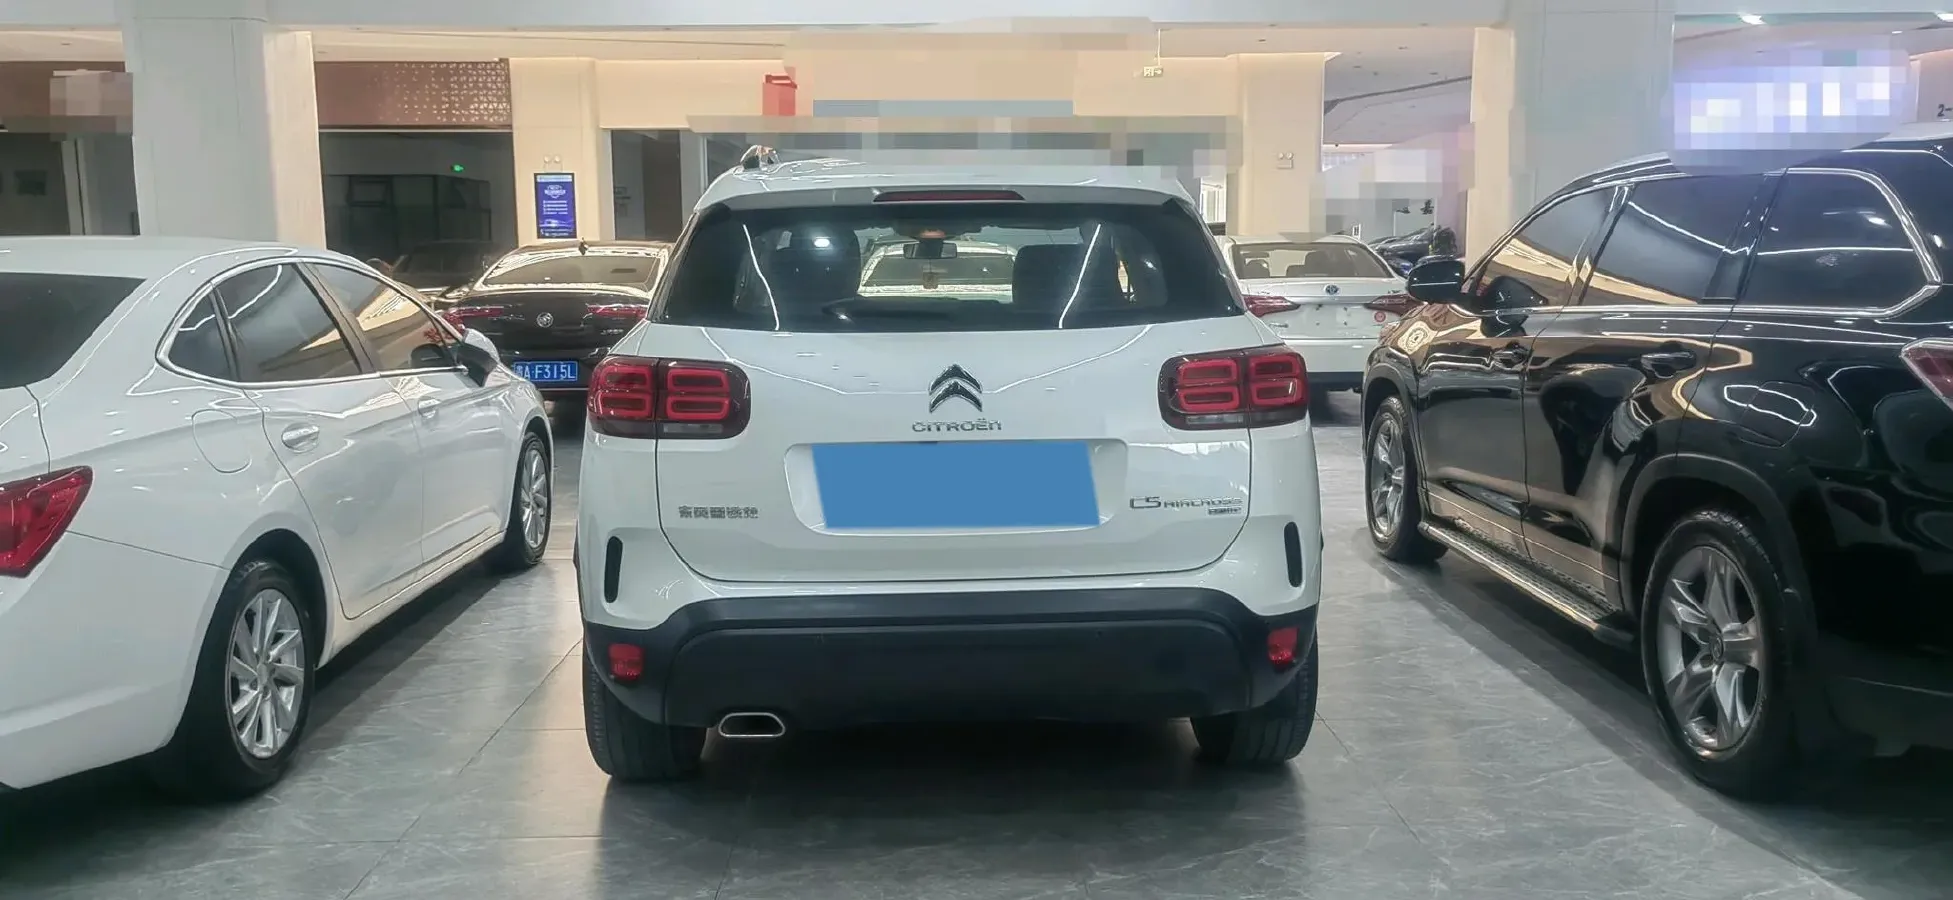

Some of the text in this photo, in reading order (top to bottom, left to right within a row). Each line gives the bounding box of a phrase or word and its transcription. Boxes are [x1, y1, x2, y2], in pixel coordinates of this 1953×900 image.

[912, 418, 1002, 432] CITROËN
[1129, 496, 1243, 509] C5 AIRCROSS
